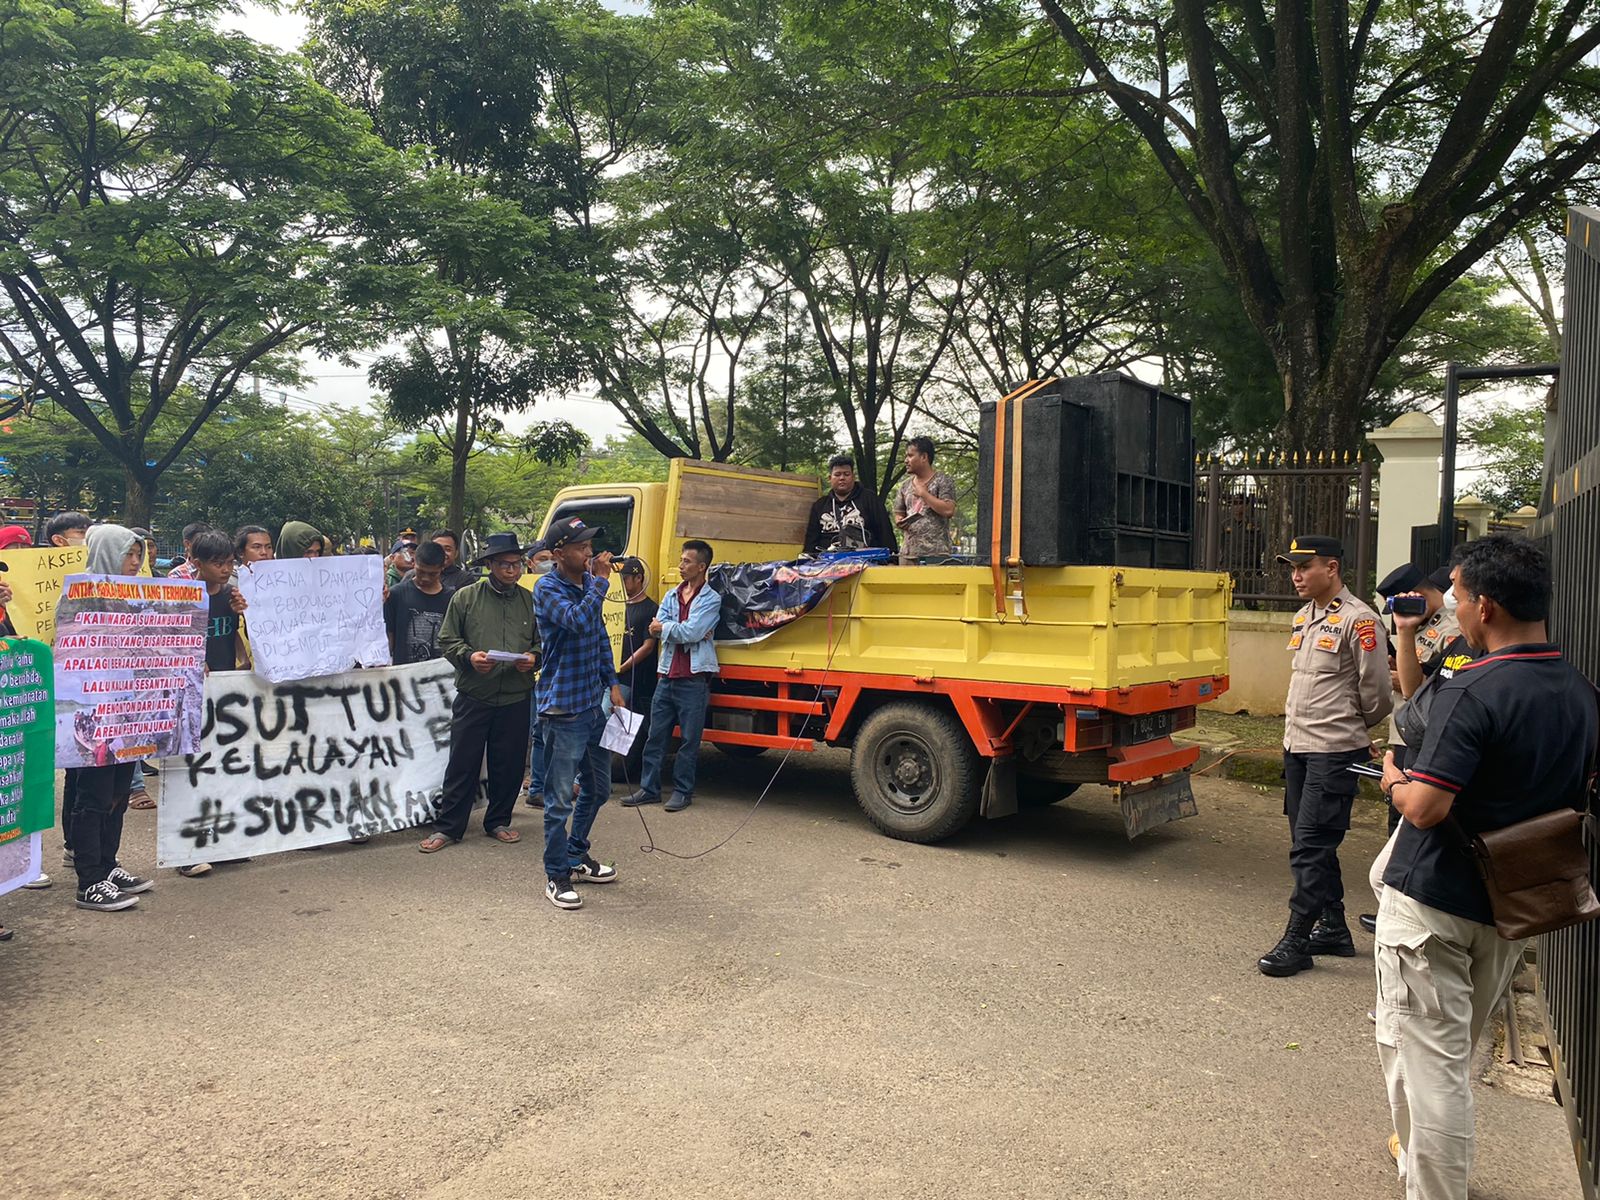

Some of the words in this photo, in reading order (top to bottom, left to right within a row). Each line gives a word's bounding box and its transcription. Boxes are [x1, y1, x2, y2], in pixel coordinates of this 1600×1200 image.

[38, 551, 82, 570] AKSES
[35, 579, 60, 594] TAK
[254, 569, 306, 593] KARNA
[319, 569, 370, 588] DAMPAK
[141, 584, 162, 601] YANG
[162, 585, 204, 602] TERHORMAT
[273, 594, 349, 614] BENDUNGAN
[107, 613, 137, 626] WARGA
[138, 614, 167, 627] SURIAN
[1320, 625, 1342, 635] POLRI
[60, 636, 86, 649] IKAN
[119, 636, 142, 648] YANG
[161, 635, 203, 648] BERENANG
[1417, 636, 1435, 649] POLRI
[64, 658, 110, 671] APALAGI
[82, 680, 111, 694] LALU
[135, 678, 172, 691] SESANTAI
[173, 677, 186, 690] ITU
[137, 700, 155, 713] DARI
[156, 699, 177, 712] ATAS
[325, 672, 455, 731] TUNT
[180, 777, 398, 848] #SURIAN
